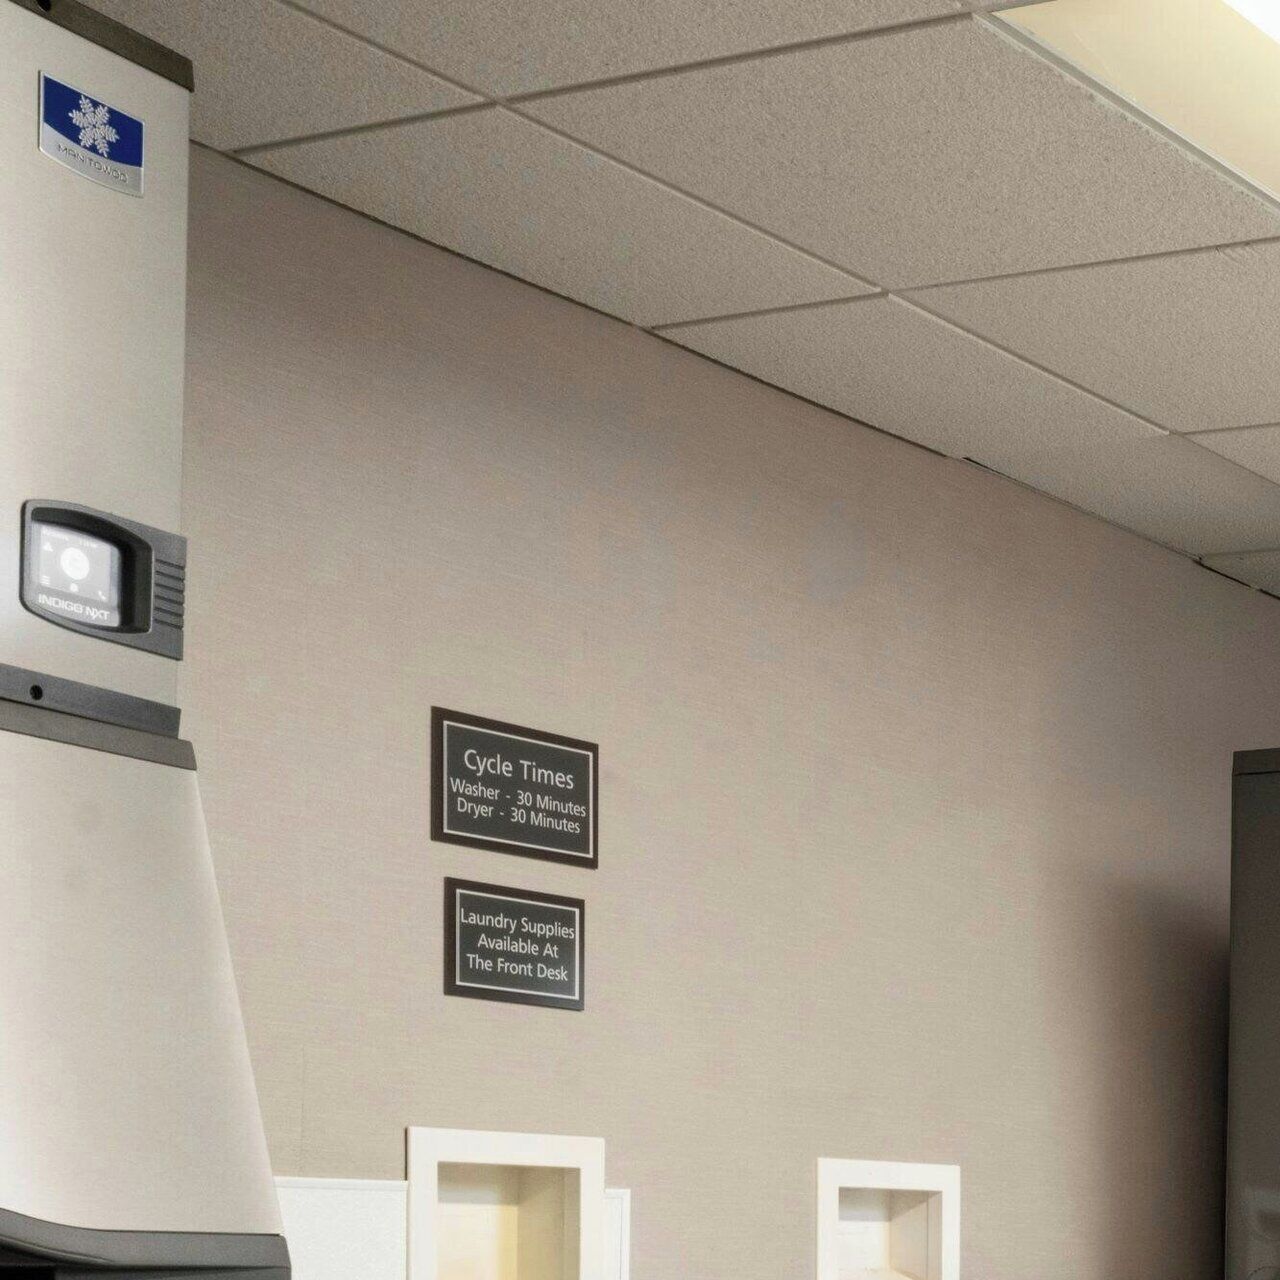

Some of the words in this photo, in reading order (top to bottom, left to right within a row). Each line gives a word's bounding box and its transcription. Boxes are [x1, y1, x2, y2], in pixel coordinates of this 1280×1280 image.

[38, 593, 84, 614] INDIGO
[86, 607, 110, 621] NXT
[464, 749, 513, 777] Cycle
[520, 759, 574, 790] Times
[450, 777, 500, 801] Washer
[516, 790, 533, 807] 30
[536, 794, 587, 818] Minutes
[457, 797, 494, 820] Dryer
[510, 807, 526, 824] 30
[530, 810, 581, 834] Minutes
[460, 908, 517, 933] Laundry
[521, 917, 575, 940] Supplies
[477, 933, 539, 956] Available
[543, 942, 559, 959] At
[466, 953, 493, 972] The
[497, 958, 533, 978] Front
[537, 964, 568, 982] Desk
